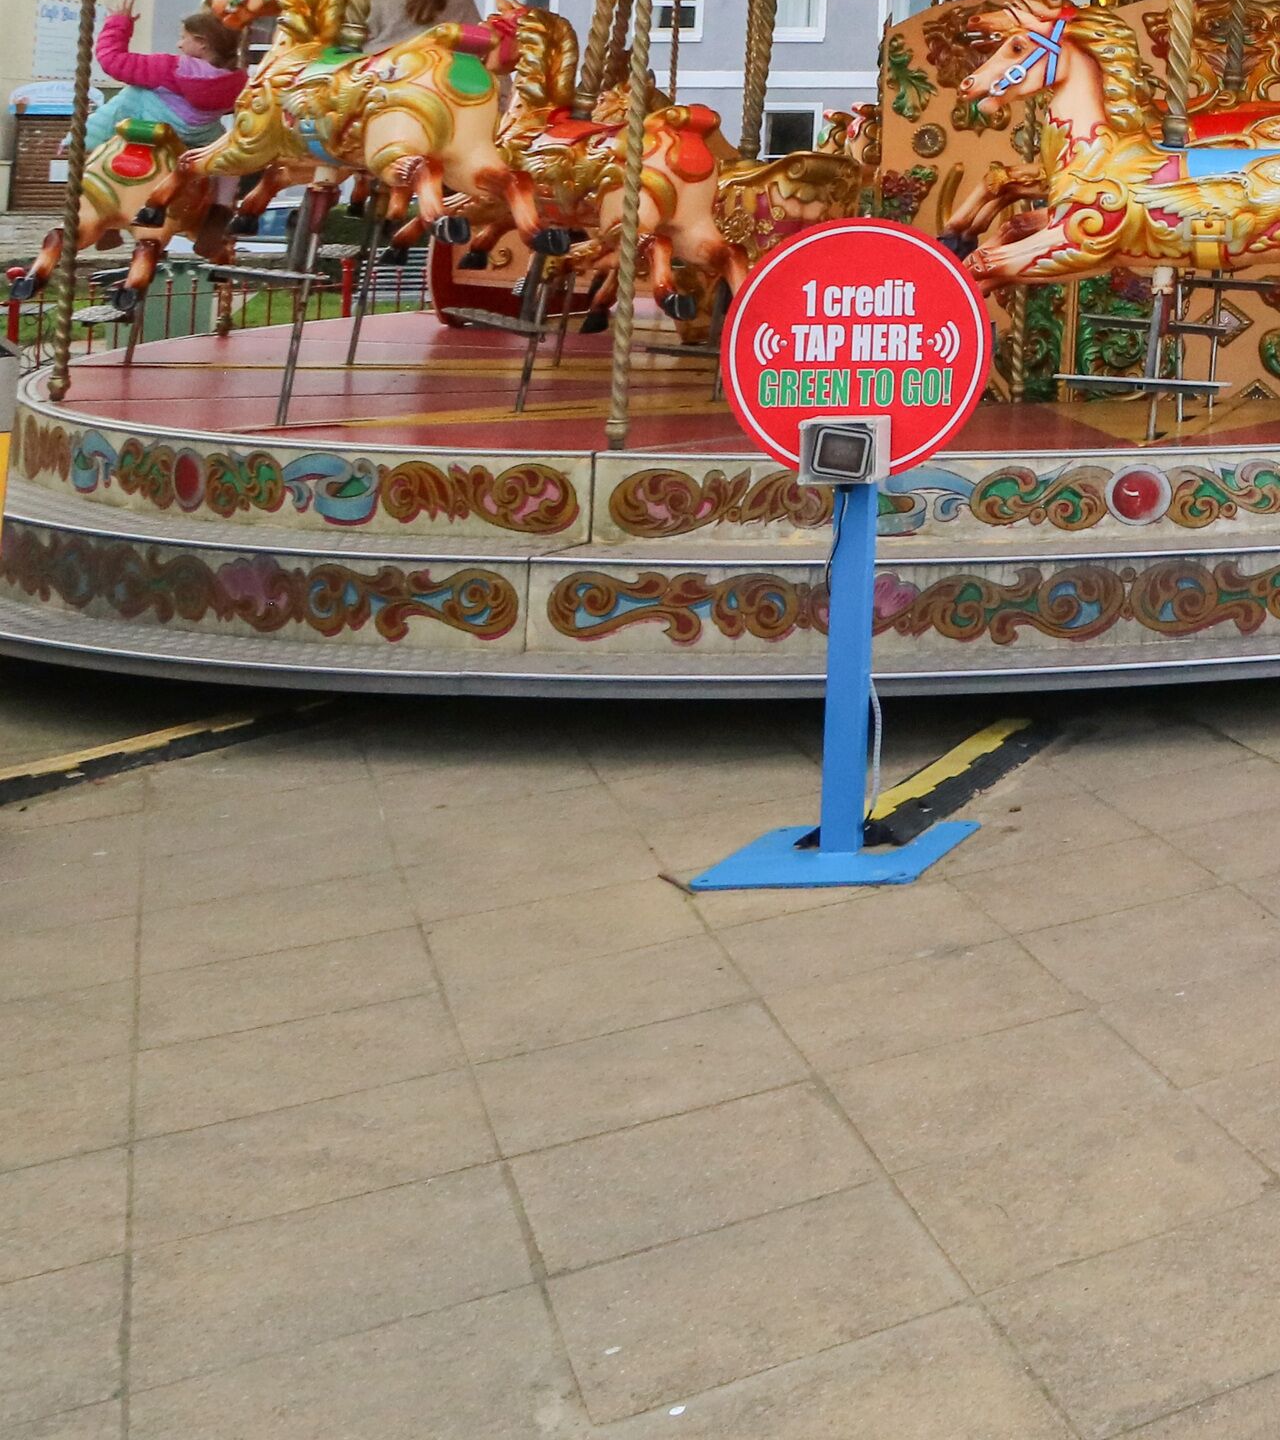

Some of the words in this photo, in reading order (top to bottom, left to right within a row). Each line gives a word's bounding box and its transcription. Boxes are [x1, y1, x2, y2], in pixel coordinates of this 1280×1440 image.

[802, 280, 817, 317] 1
[823, 279, 916, 317] credit
[791, 324, 847, 362] TAP
[851, 324, 923, 362] HERE
[758, 369, 849, 408] GREEN
[857, 368, 895, 407] TO
[901, 367, 954, 407] GO!
